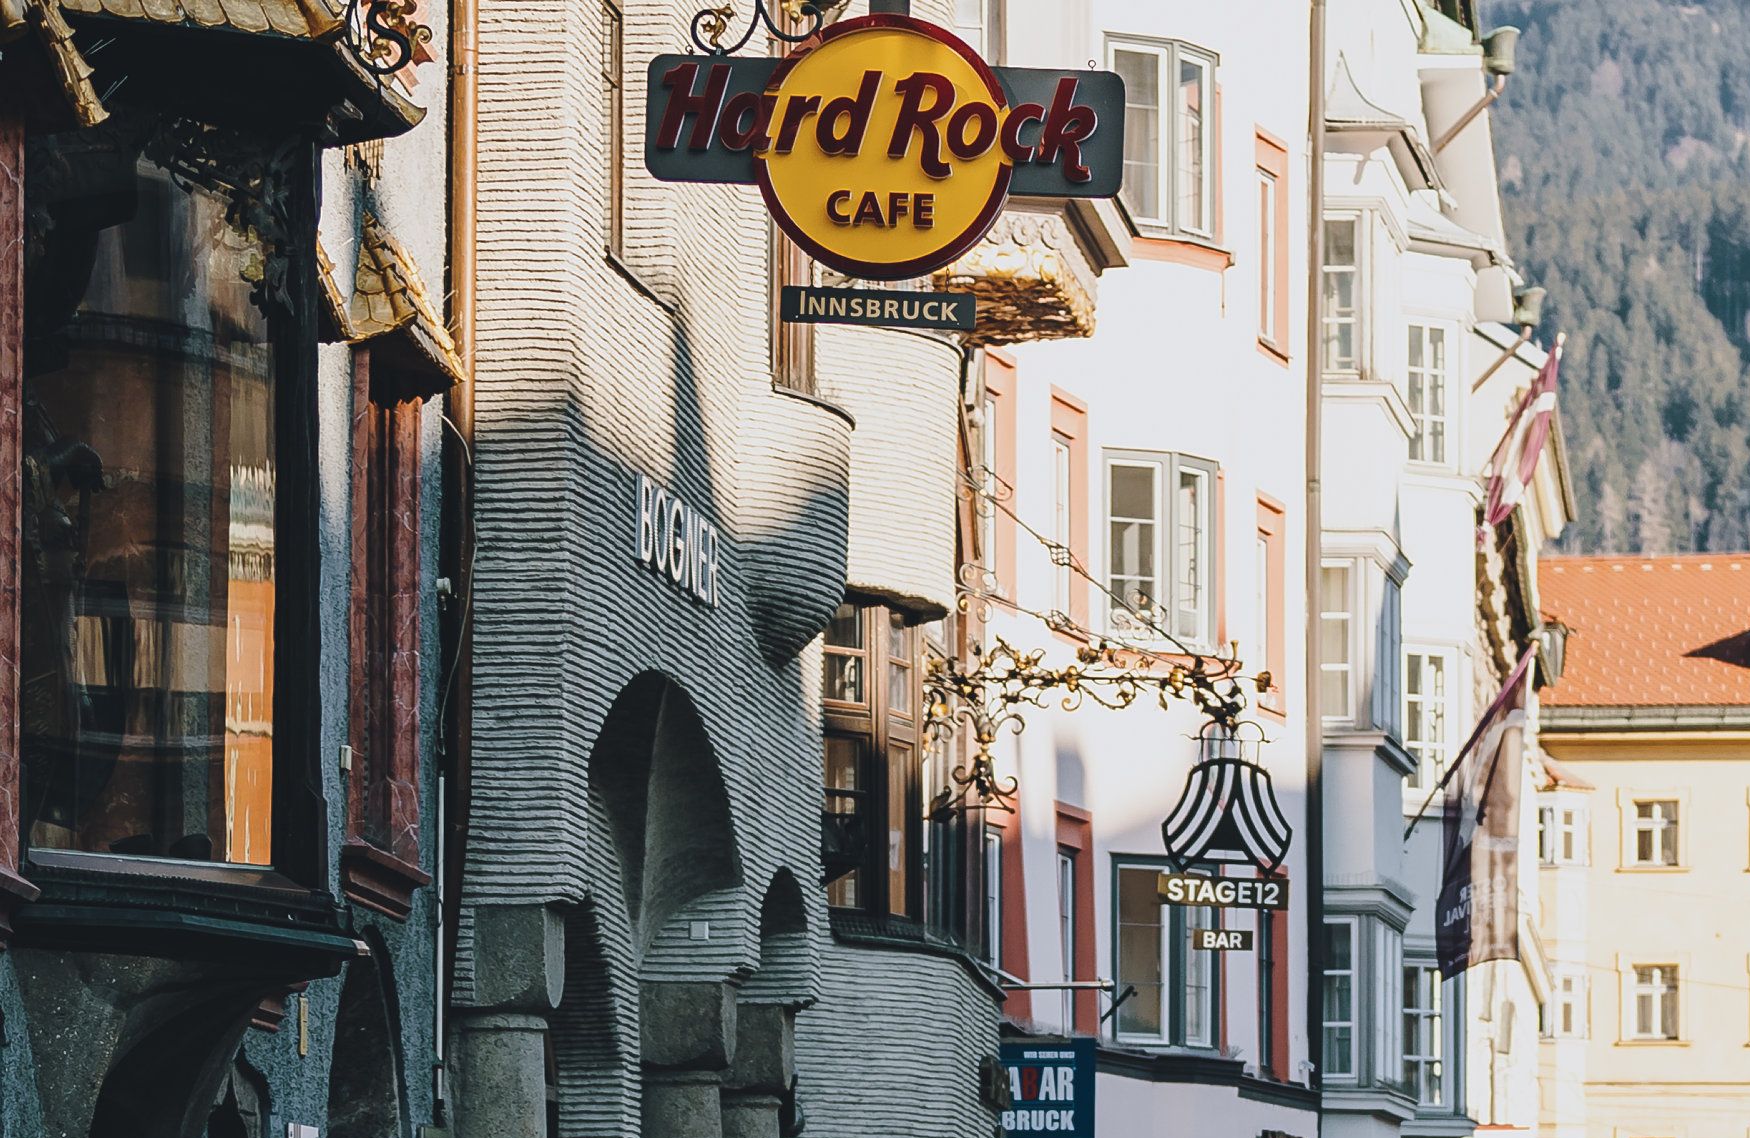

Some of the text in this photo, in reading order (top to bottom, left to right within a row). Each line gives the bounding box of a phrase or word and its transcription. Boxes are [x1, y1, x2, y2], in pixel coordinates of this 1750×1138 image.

[655, 62, 1098, 184] Hard Rock
[826, 190, 936, 230] CAFE
[799, 290, 960, 323] INNSBRUCK
[637, 474, 720, 609] BOGNER
[1167, 878, 1279, 906] STAGE12
[1202, 931, 1243, 949] BAR
